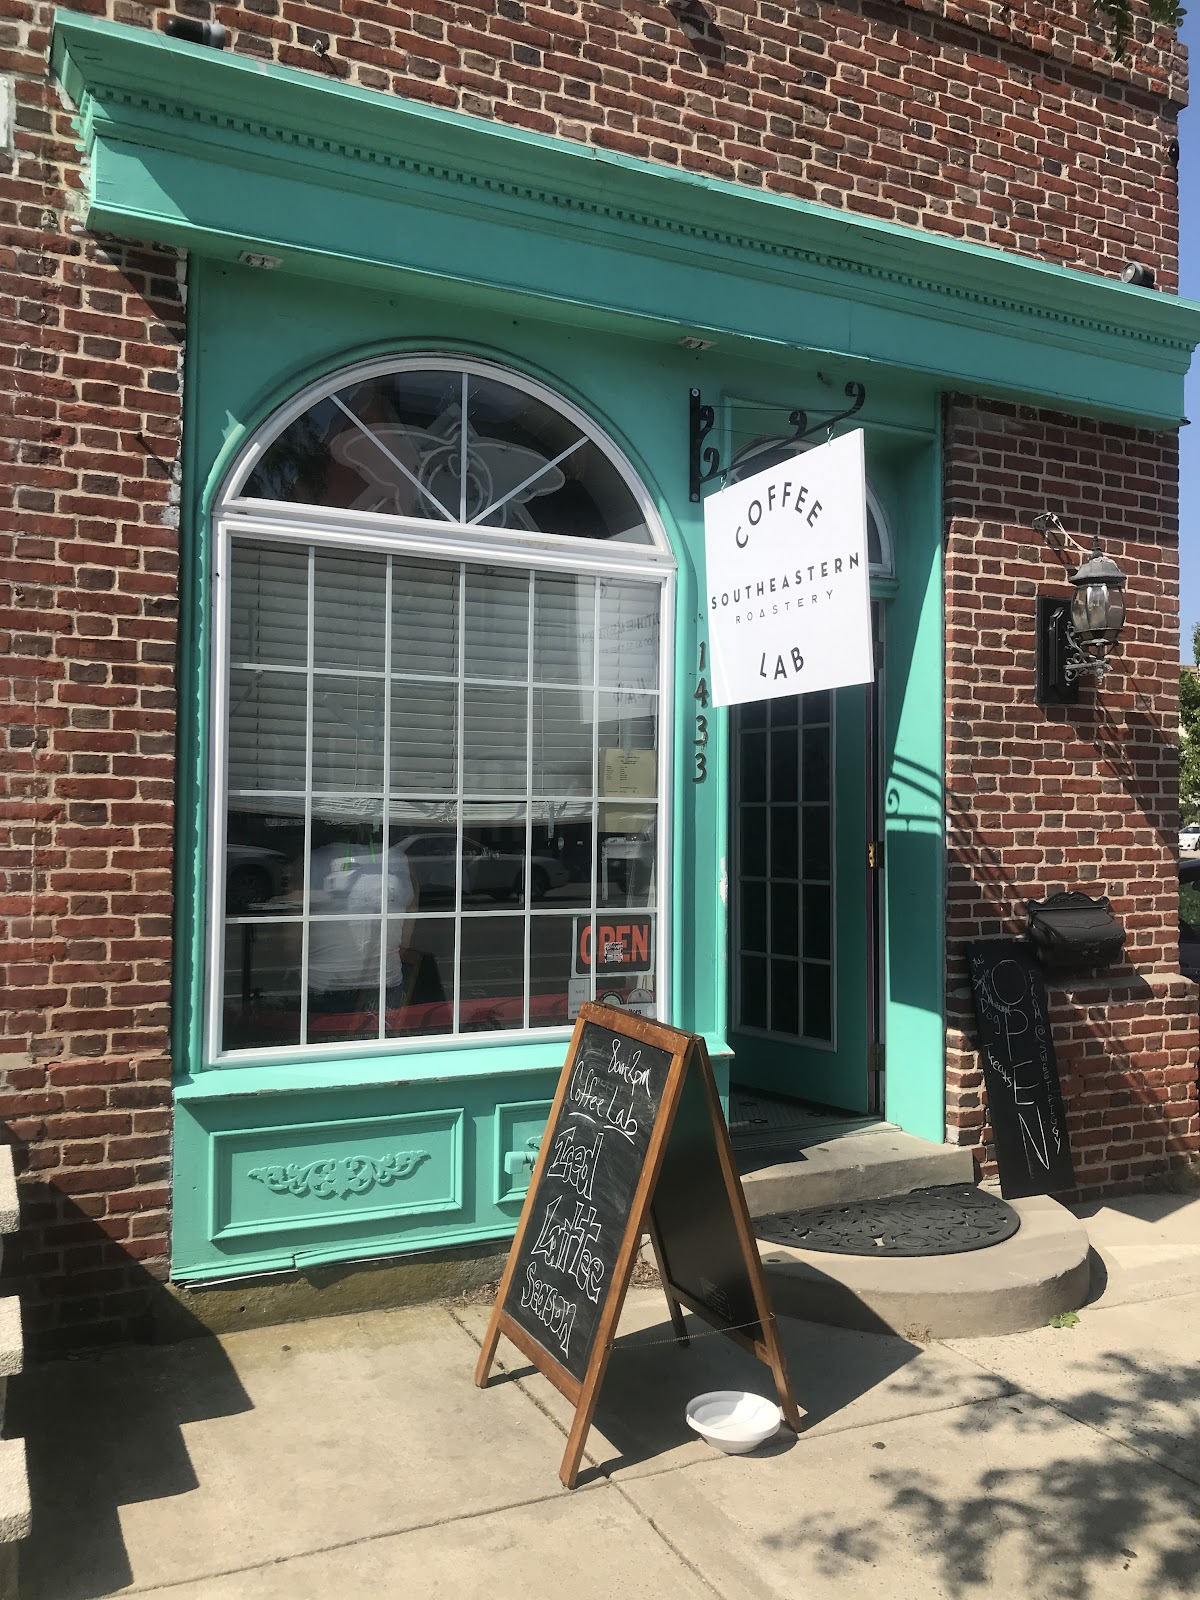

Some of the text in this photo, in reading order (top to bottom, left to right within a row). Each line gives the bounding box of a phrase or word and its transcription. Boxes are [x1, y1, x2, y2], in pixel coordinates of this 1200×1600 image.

[735, 481, 823, 549] COFFEE
[711, 552, 860, 610] SOUTHEASTERN
[735, 590, 834, 624] ROASTERY
[759, 646, 804, 680] LAB
[691, 641, 709, 784] 1433
[580, 924, 649, 965] OPEN
[980, 999, 1001, 1034] Dog
[569, 1060, 638, 1136] Coffee Lab
[984, 1043, 1013, 1088] Treats
[991, 959, 1050, 1180] OPEN
[547, 1126, 604, 1201] Iced
[531, 1195, 605, 1304] Latte
[521, 1261, 578, 1359] Season
